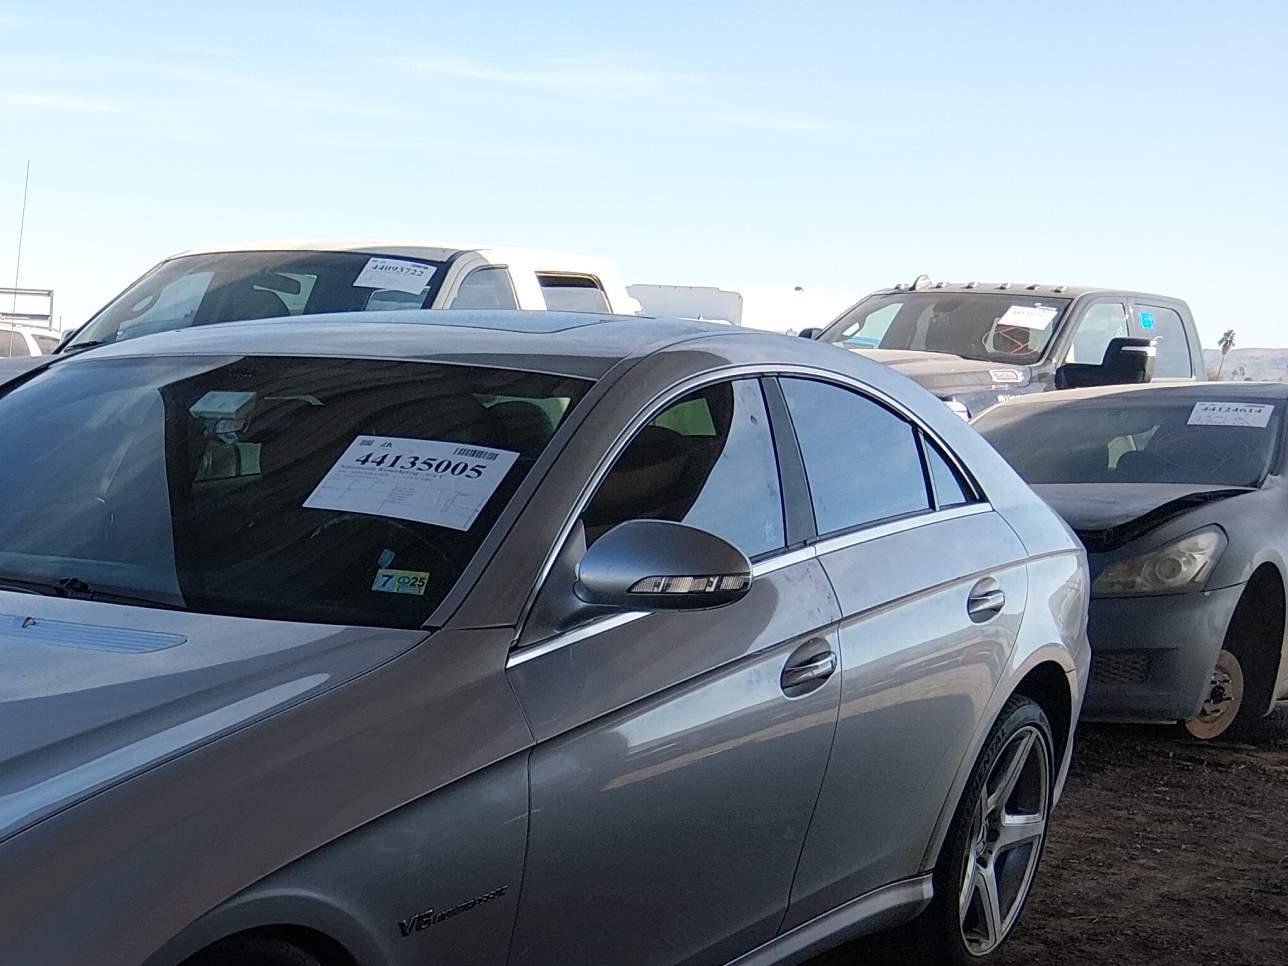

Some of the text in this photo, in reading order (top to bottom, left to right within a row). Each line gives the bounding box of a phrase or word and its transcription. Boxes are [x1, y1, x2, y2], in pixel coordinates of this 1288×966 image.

[355, 452, 487, 479] 44135005
[382, 575, 426, 587] 7 25
